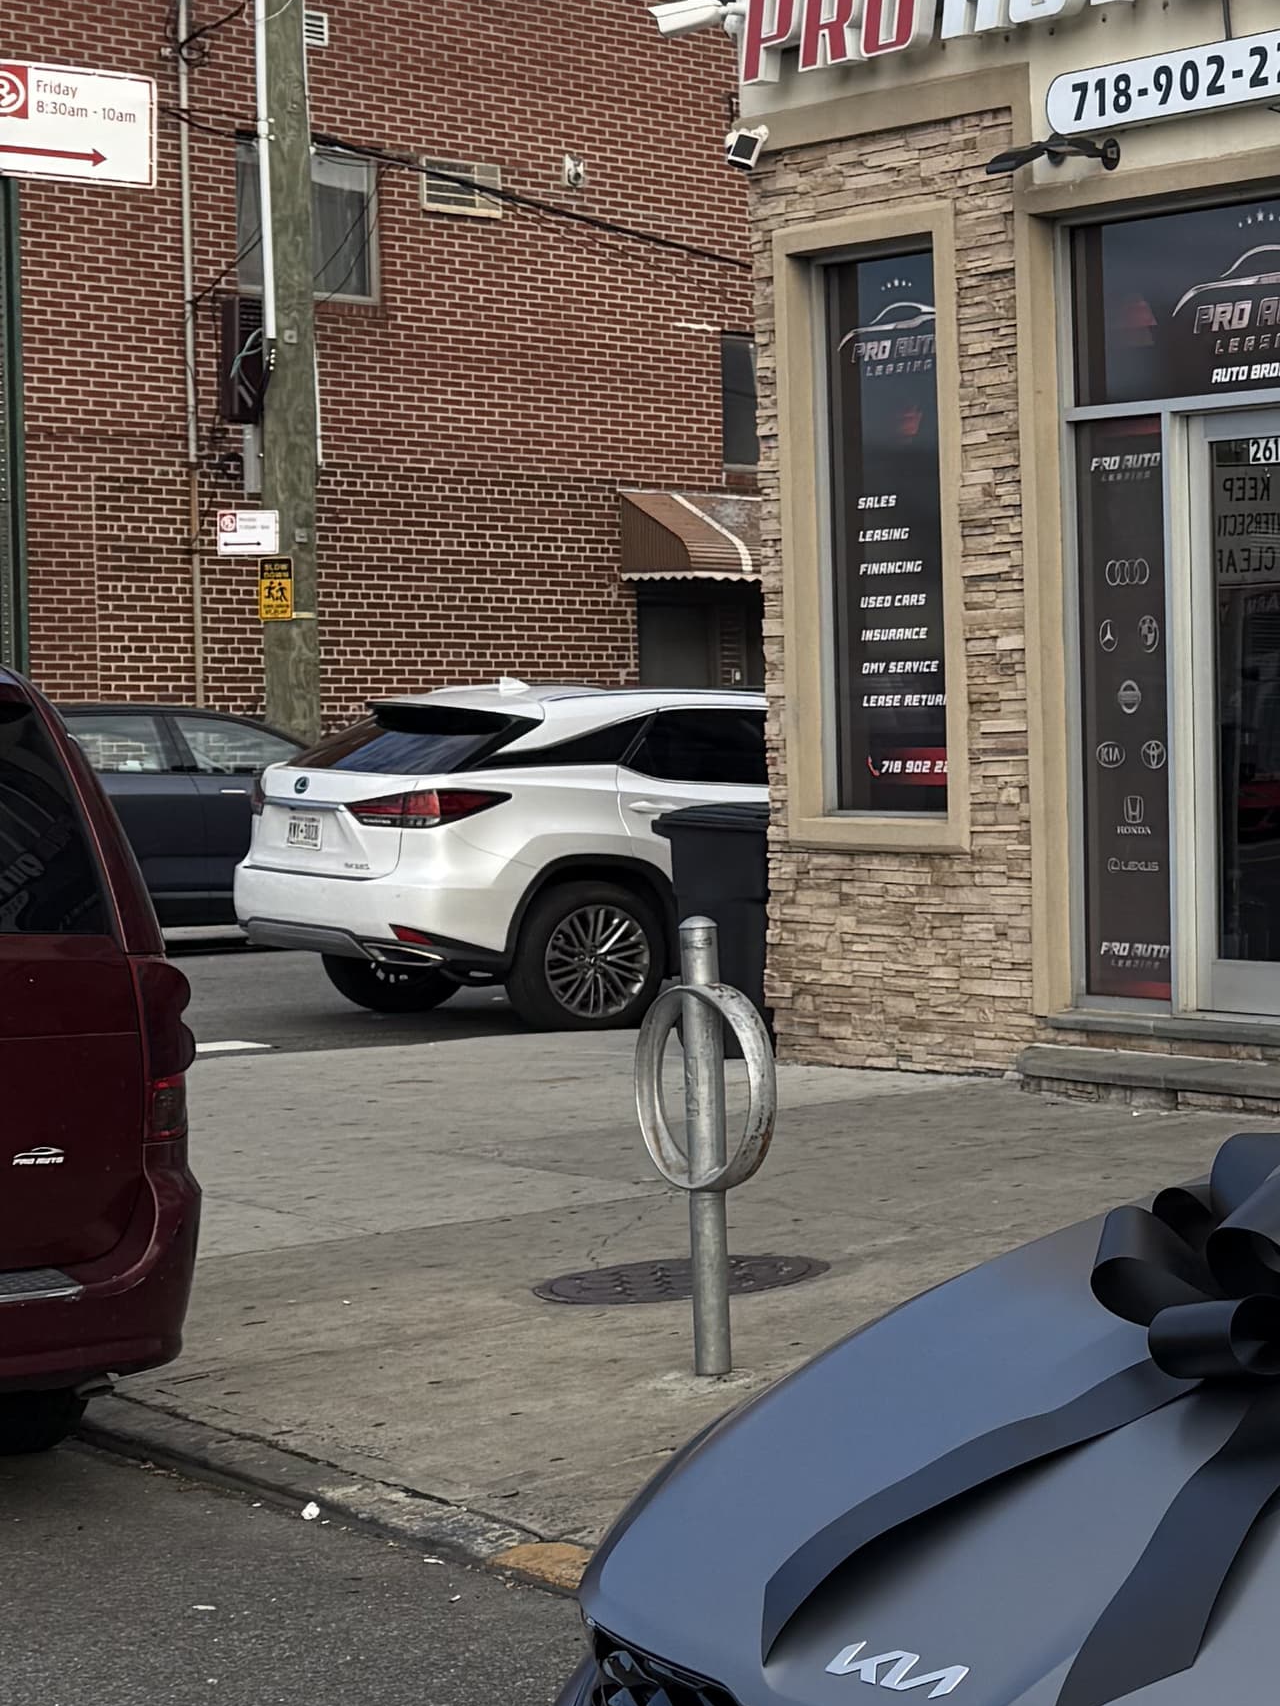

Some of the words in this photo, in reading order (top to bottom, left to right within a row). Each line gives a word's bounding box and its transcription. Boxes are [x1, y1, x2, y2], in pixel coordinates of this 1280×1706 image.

[36, 80, 78, 98] Friday
[36, 100, 88, 118] 8:30am
[102, 107, 136, 123] 10am
[1193, 300, 1252, 334] PRO
[852, 342, 892, 364] PRO
[894, 334, 936, 358] AUT
[1211, 365, 1249, 384] AUTO
[1090, 456, 1120, 471] PRO
[1122, 452, 1160, 469] AUTO
[857, 494, 897, 510] SALES
[859, 527, 910, 543] LEASING
[859, 561, 922, 575] FINANCING
[860, 595, 892, 608] USED
[894, 593, 926, 607] CARS
[861, 627, 928, 641] INSURANCE
[862, 662, 886, 674] DMV
[888, 660, 939, 673] SERVICE
[863, 695, 901, 707] LEASE
[881, 760, 902, 773] 718
[905, 761, 931, 773] 902
[1117, 826, 1151, 834] HONDA
[1121, 861, 1159, 871] LEXUS
[1100, 941, 1129, 955] PRO
[1131, 943, 1170, 958] AUTO
